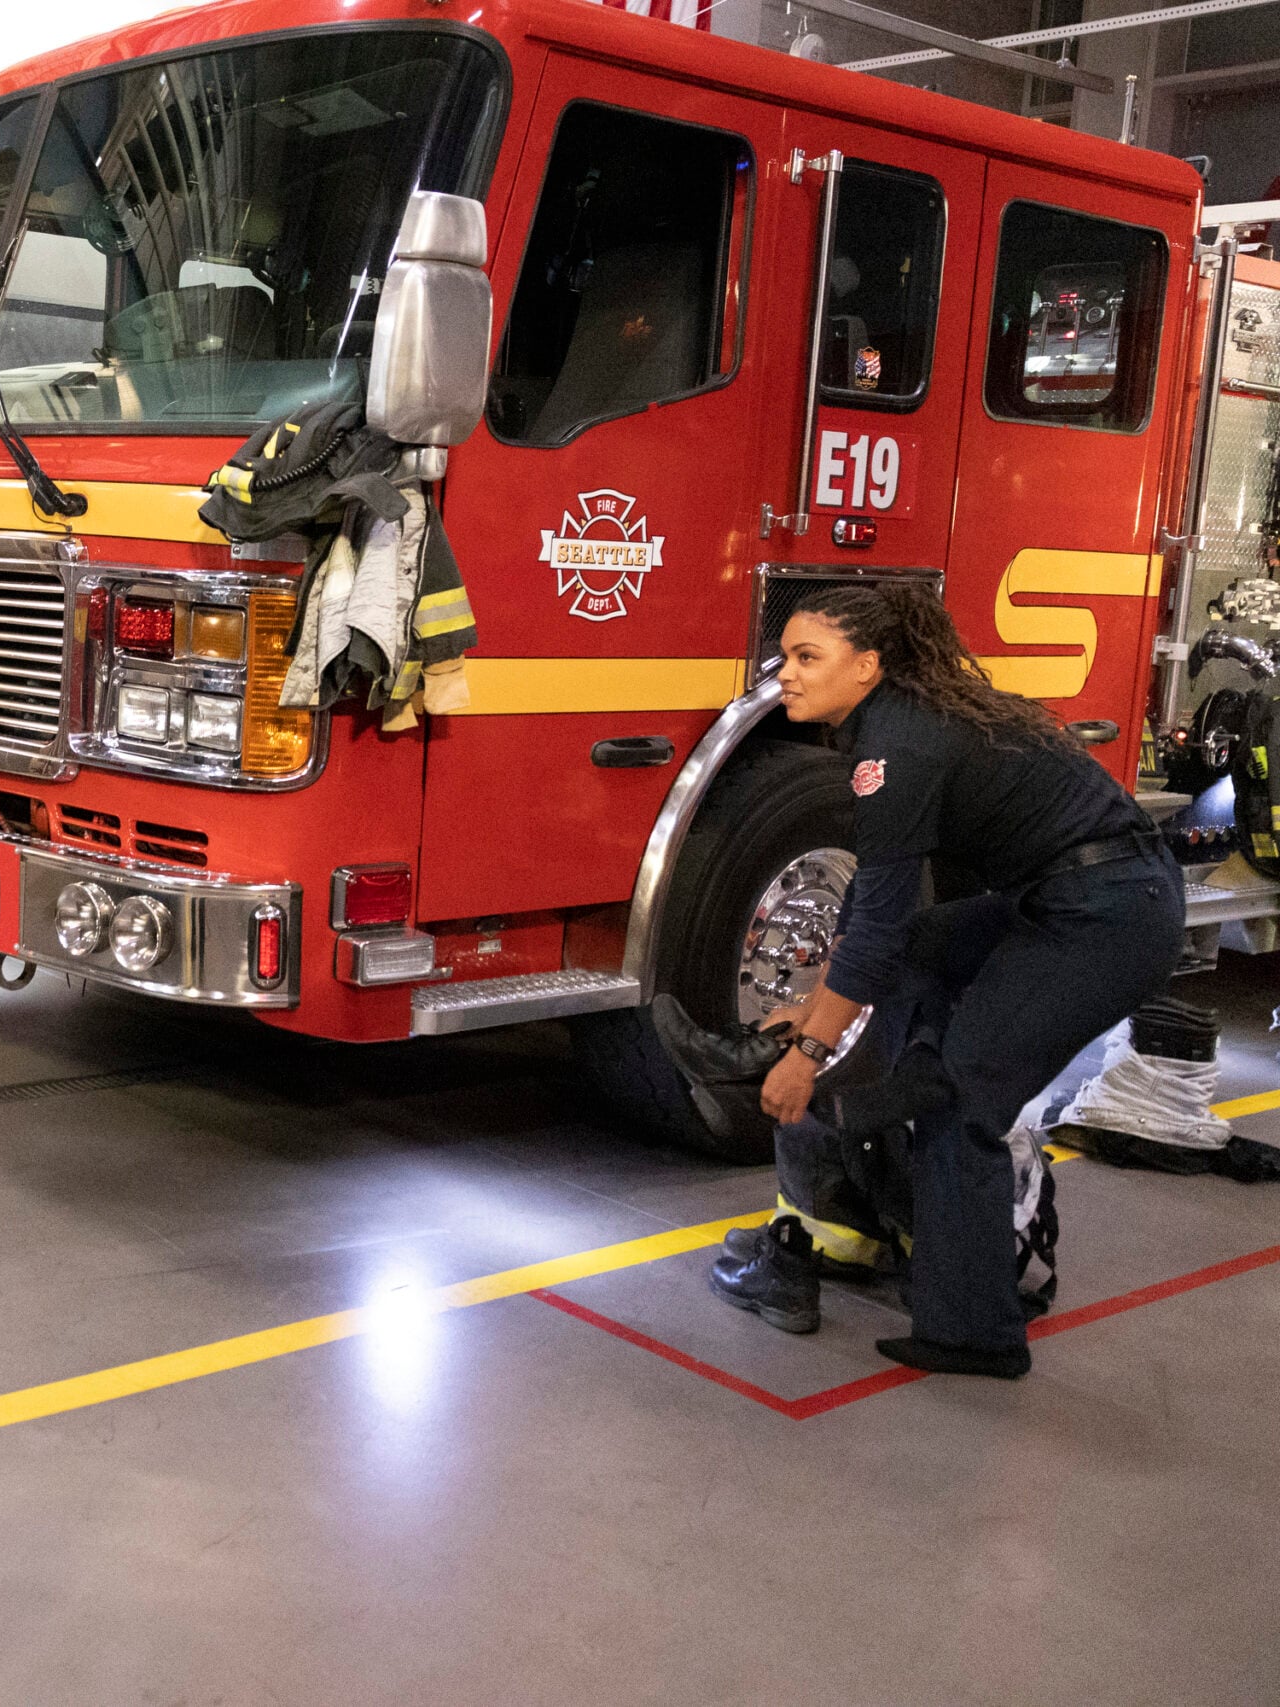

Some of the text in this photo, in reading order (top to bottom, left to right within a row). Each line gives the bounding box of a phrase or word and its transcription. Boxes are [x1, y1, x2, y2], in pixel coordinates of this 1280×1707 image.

[815, 430, 901, 511] E19
[597, 499, 617, 513] FIRE
[556, 543, 647, 567] SEATTLE
[587, 597, 613, 612] DEPT.
